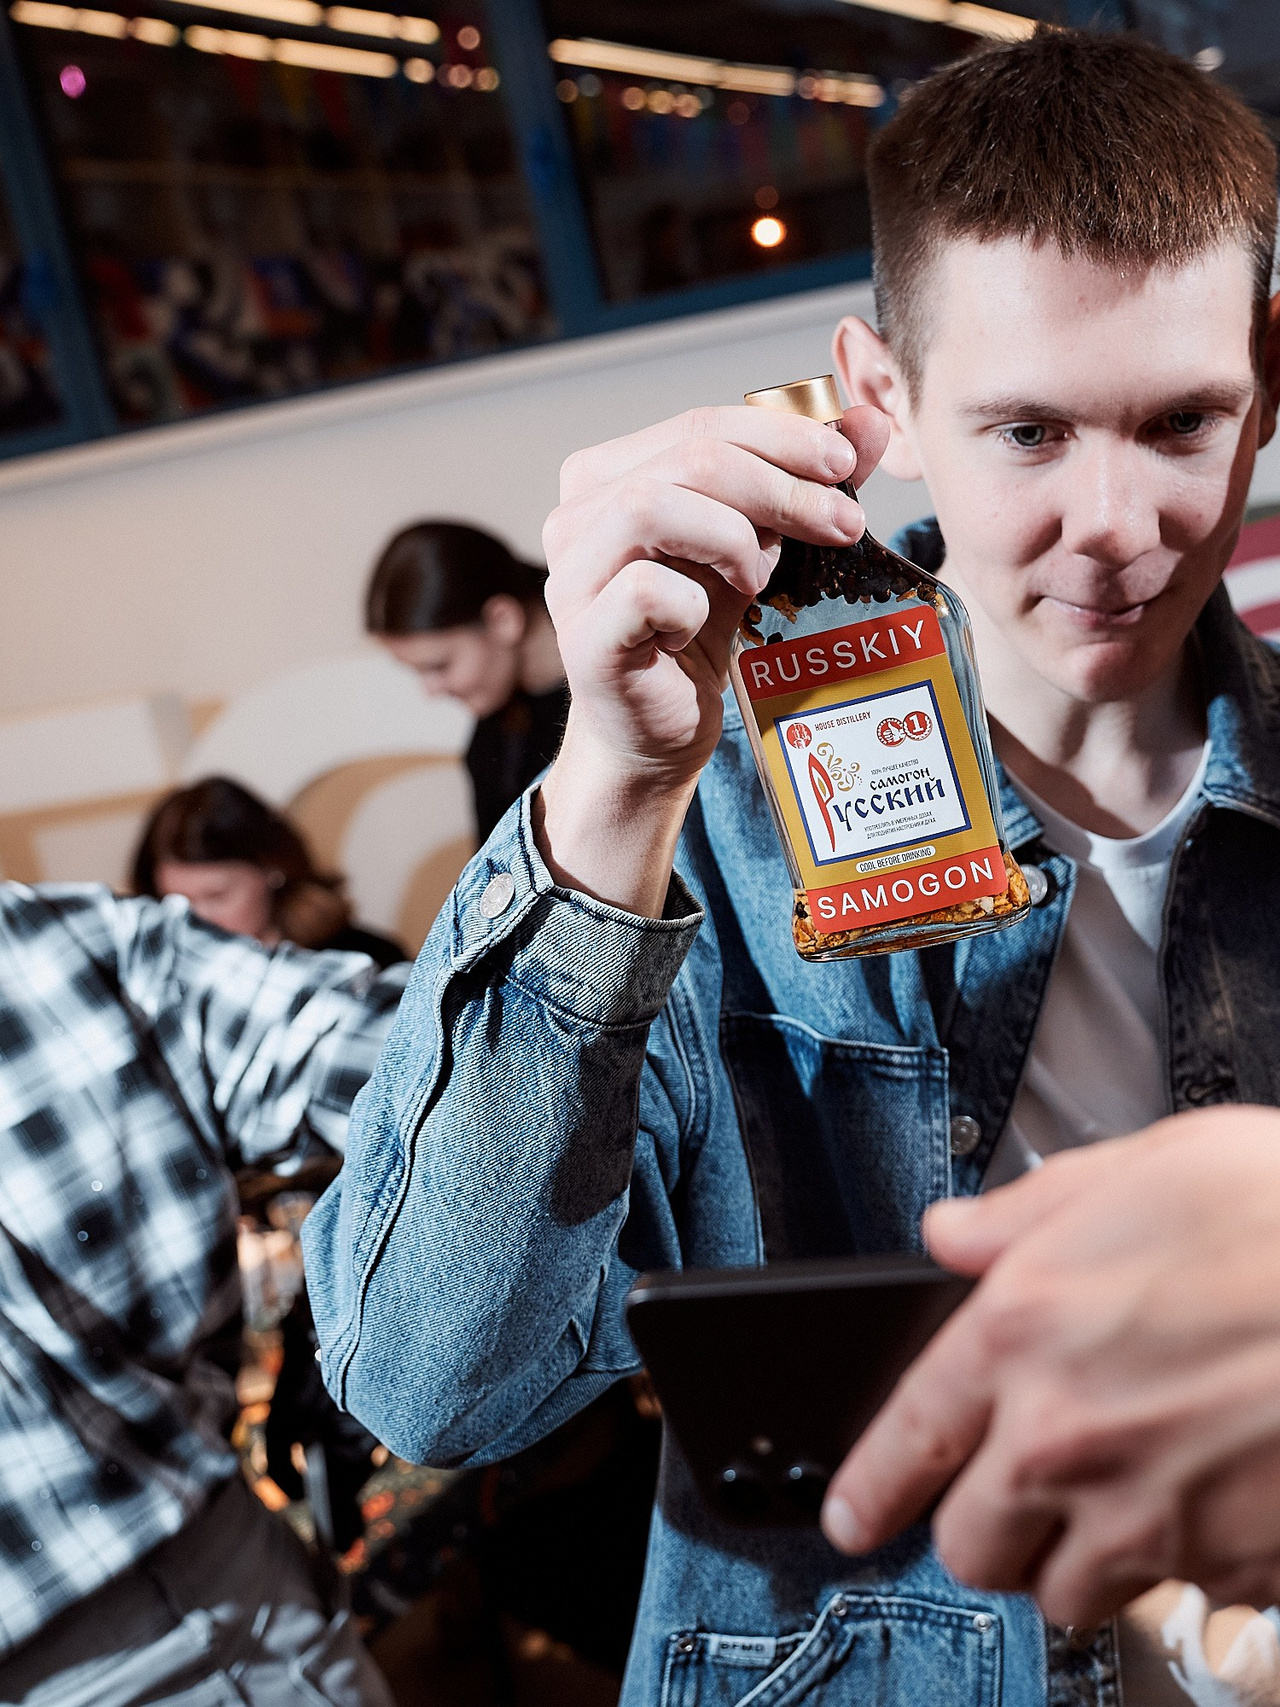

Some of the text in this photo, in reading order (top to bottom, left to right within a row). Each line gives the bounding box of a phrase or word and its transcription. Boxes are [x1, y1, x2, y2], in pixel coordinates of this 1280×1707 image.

[750, 619, 924, 689] RUSSKIY
[814, 711, 872, 731] HOUSE DISTILLERY
[909, 714, 924, 733] 1
[860, 847, 932, 872] COOL BEFORE DRINKING
[817, 857, 994, 919] SAMOGON
